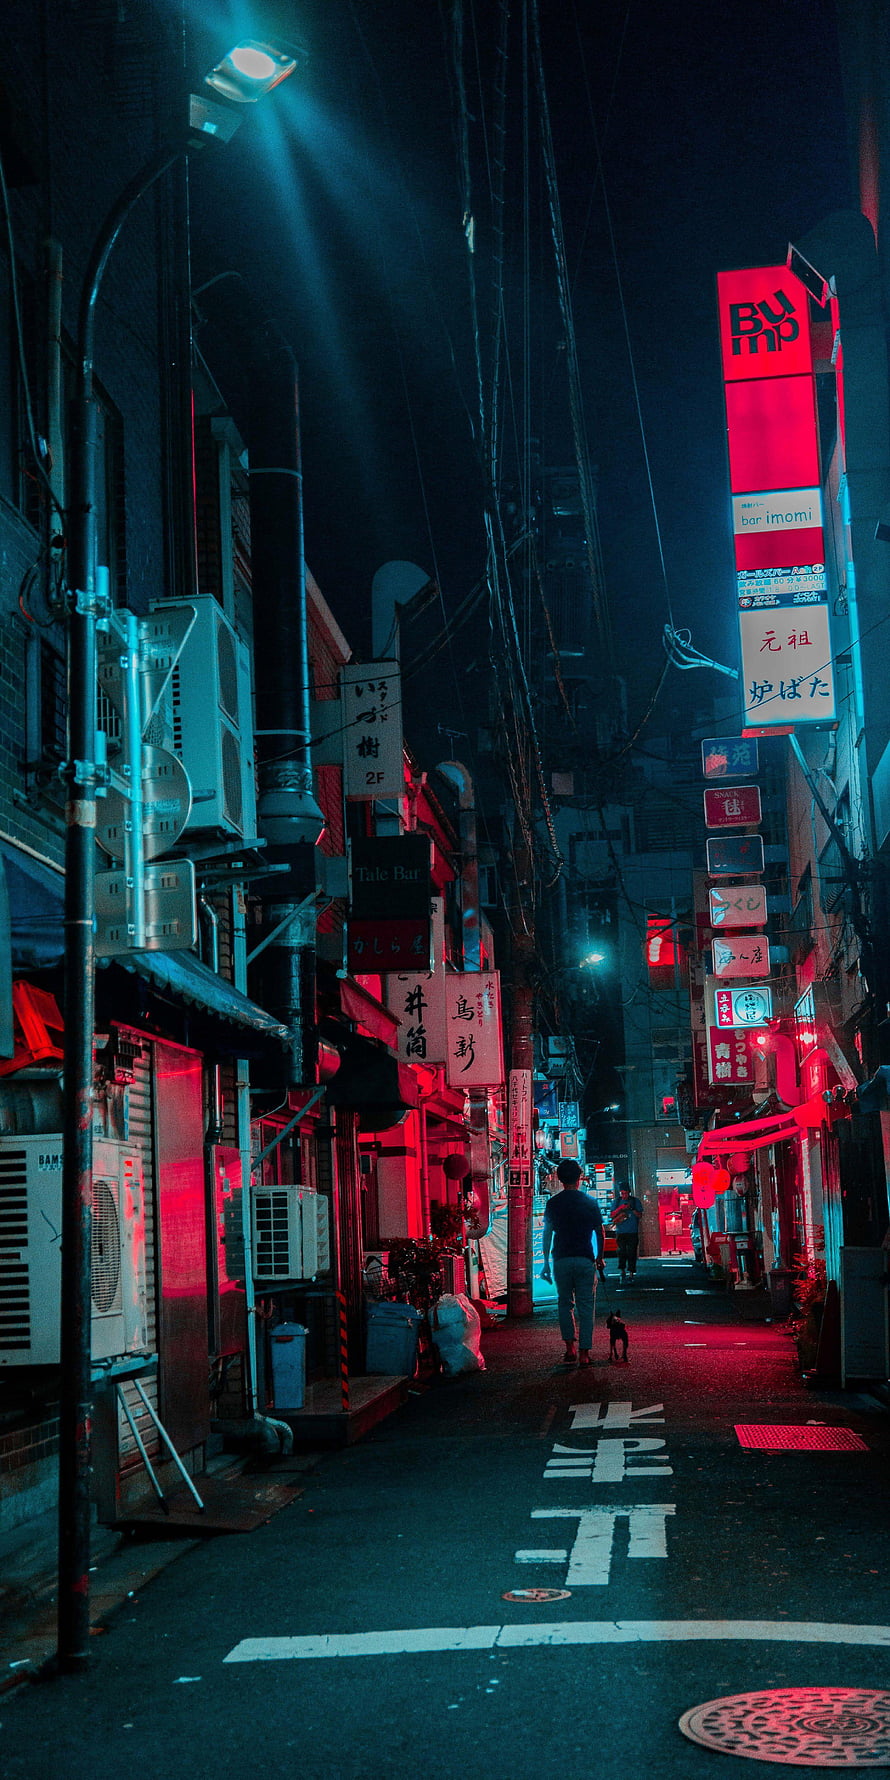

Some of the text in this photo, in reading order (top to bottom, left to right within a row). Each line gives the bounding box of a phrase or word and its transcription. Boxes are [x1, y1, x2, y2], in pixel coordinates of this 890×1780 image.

[741, 507, 812, 526] bar imomi
[759, 629, 813, 652] 元祖
[749, 676, 830, 704] 炉ばた
[377, 680, 388, 723] スタンド
[366, 772, 385, 784] 2F
[713, 791, 740, 799] SNACK
[355, 865, 421, 882] Tale Bar
[352, 934, 426, 955] かしら屋
[475, 992, 484, 1027] やきとり
